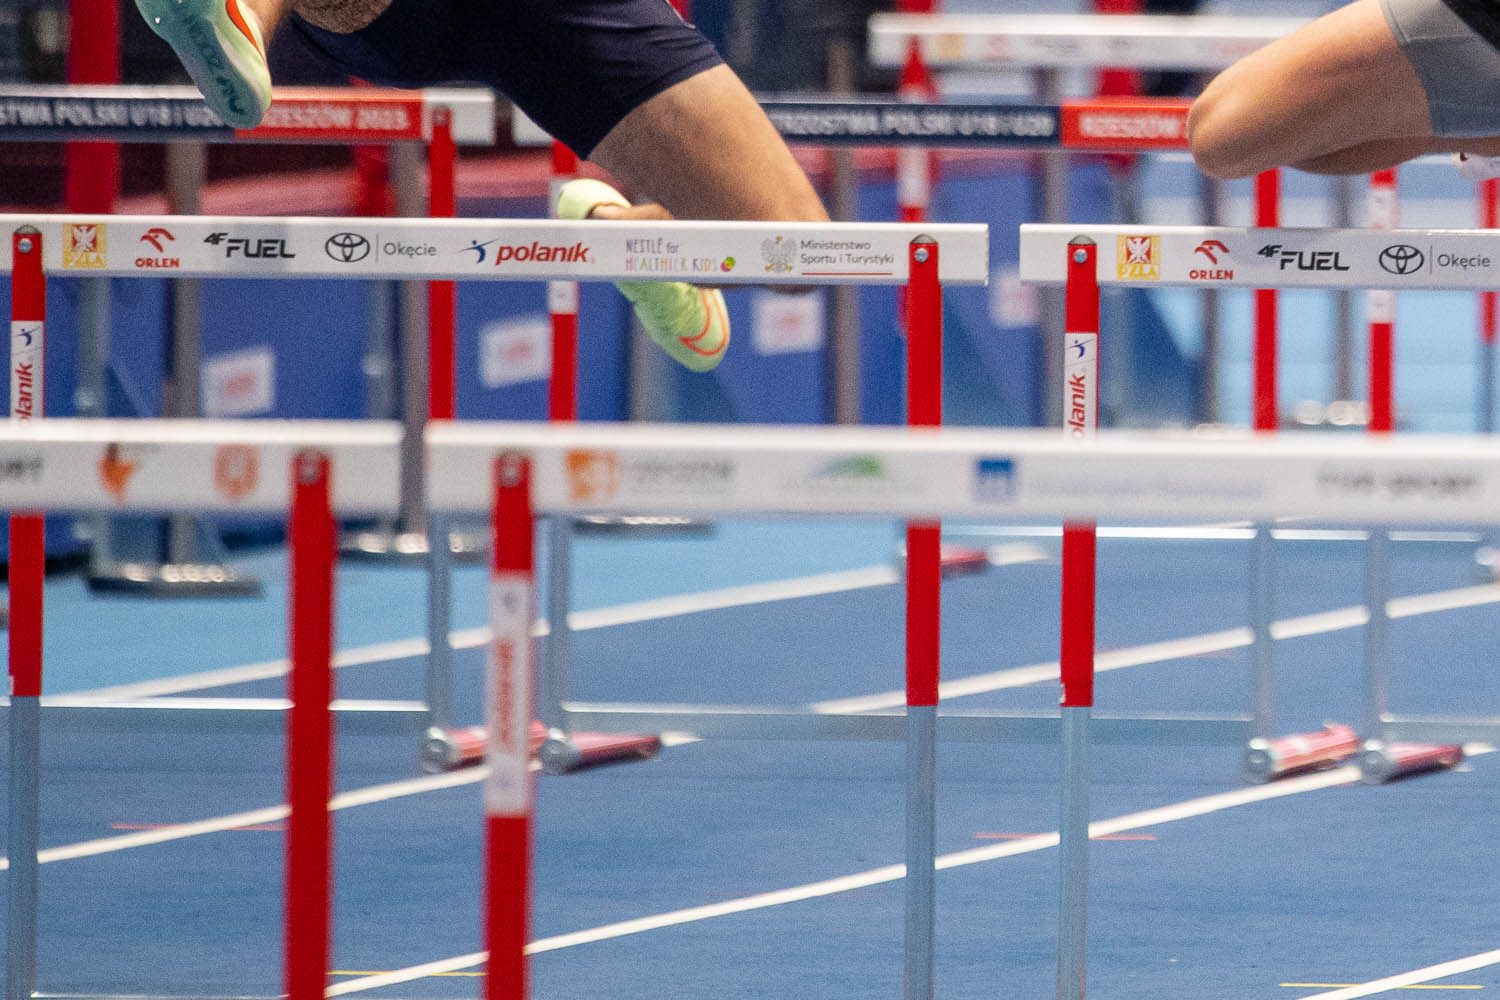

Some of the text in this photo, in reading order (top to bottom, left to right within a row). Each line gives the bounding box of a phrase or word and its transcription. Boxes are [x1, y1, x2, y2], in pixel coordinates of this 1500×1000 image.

[226, 239, 296, 258] FUEL
[383, 242, 437, 257] Okęcie
[666, 241, 680, 255] for
[800, 239, 871, 251] Ministerstwo
[495, 241, 591, 266] polanik
[800, 253, 837, 267] Sportu
[845, 253, 894, 267] Turystyki
[1279, 250, 1350, 271] FUEL
[135, 258, 180, 269] ORLEN
[625, 256, 718, 273] HEALTHIER KIDS
[1437, 253, 1491, 270] Okęcie
[1189, 270, 1234, 281] ORLEN
